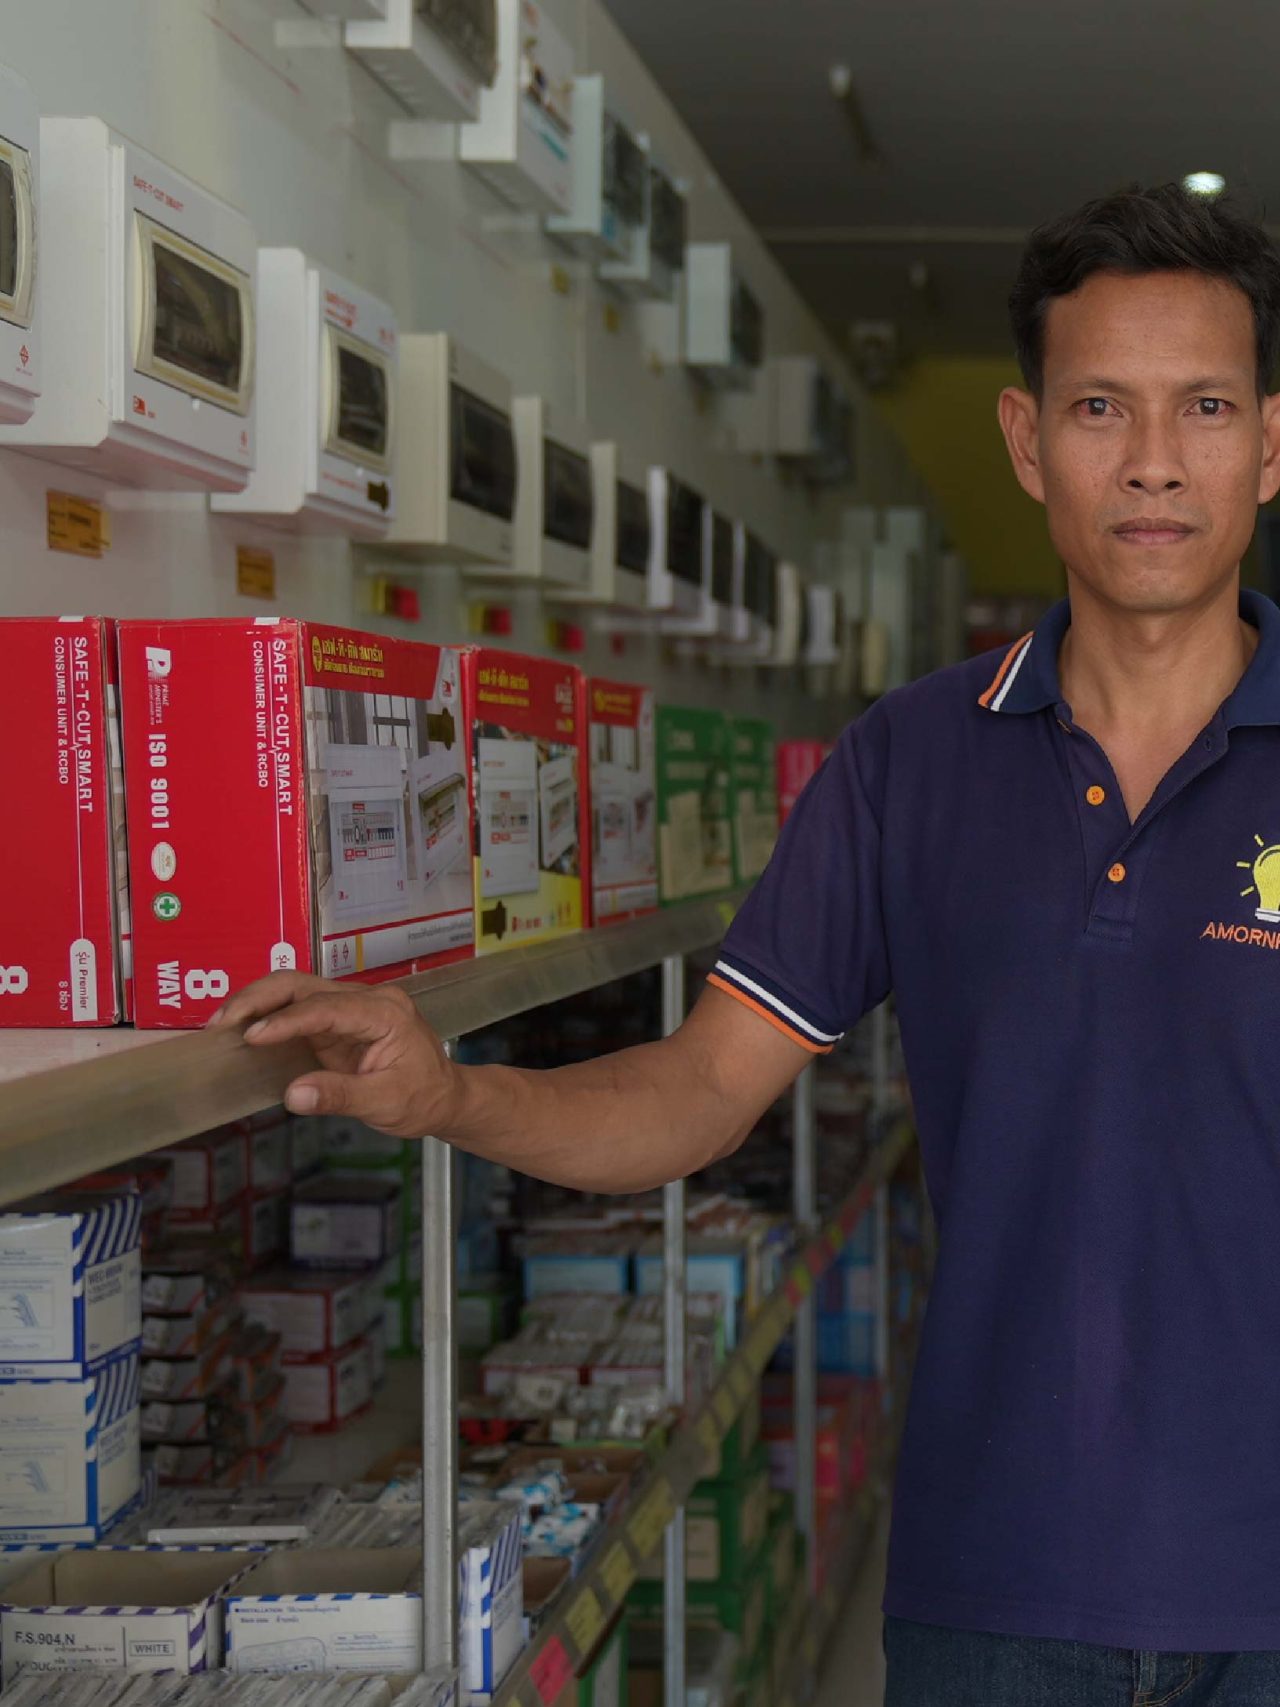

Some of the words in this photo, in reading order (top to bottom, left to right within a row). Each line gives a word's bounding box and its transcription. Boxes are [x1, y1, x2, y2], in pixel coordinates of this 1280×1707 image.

[53, 635, 67, 705] CONSUMER
[252, 640, 268, 709] CONSUMER
[73, 635, 93, 746] SAFE-T-CUT
[161, 684, 170, 707] PRIME
[272, 639, 290, 748] SAFE-T-CUT
[57, 707, 67, 734] UNIT
[256, 711, 268, 739] UNIT
[58, 736, 68, 748] &
[148, 733, 168, 767] ISO
[257, 741, 268, 751] &
[58, 749, 69, 785] RCBO
[77, 746, 94, 813] SMART
[257, 753, 269, 788] RCBO
[275, 751, 293, 816] SMART
[149, 777, 170, 829] 9001
[78, 968, 90, 1010] Premier
[156, 959, 182, 1009] WAY
[184, 968, 230, 1000] 8
[14, 1631, 76, 1646] F.S.904.N
[133, 1644, 170, 1654] WHITE
